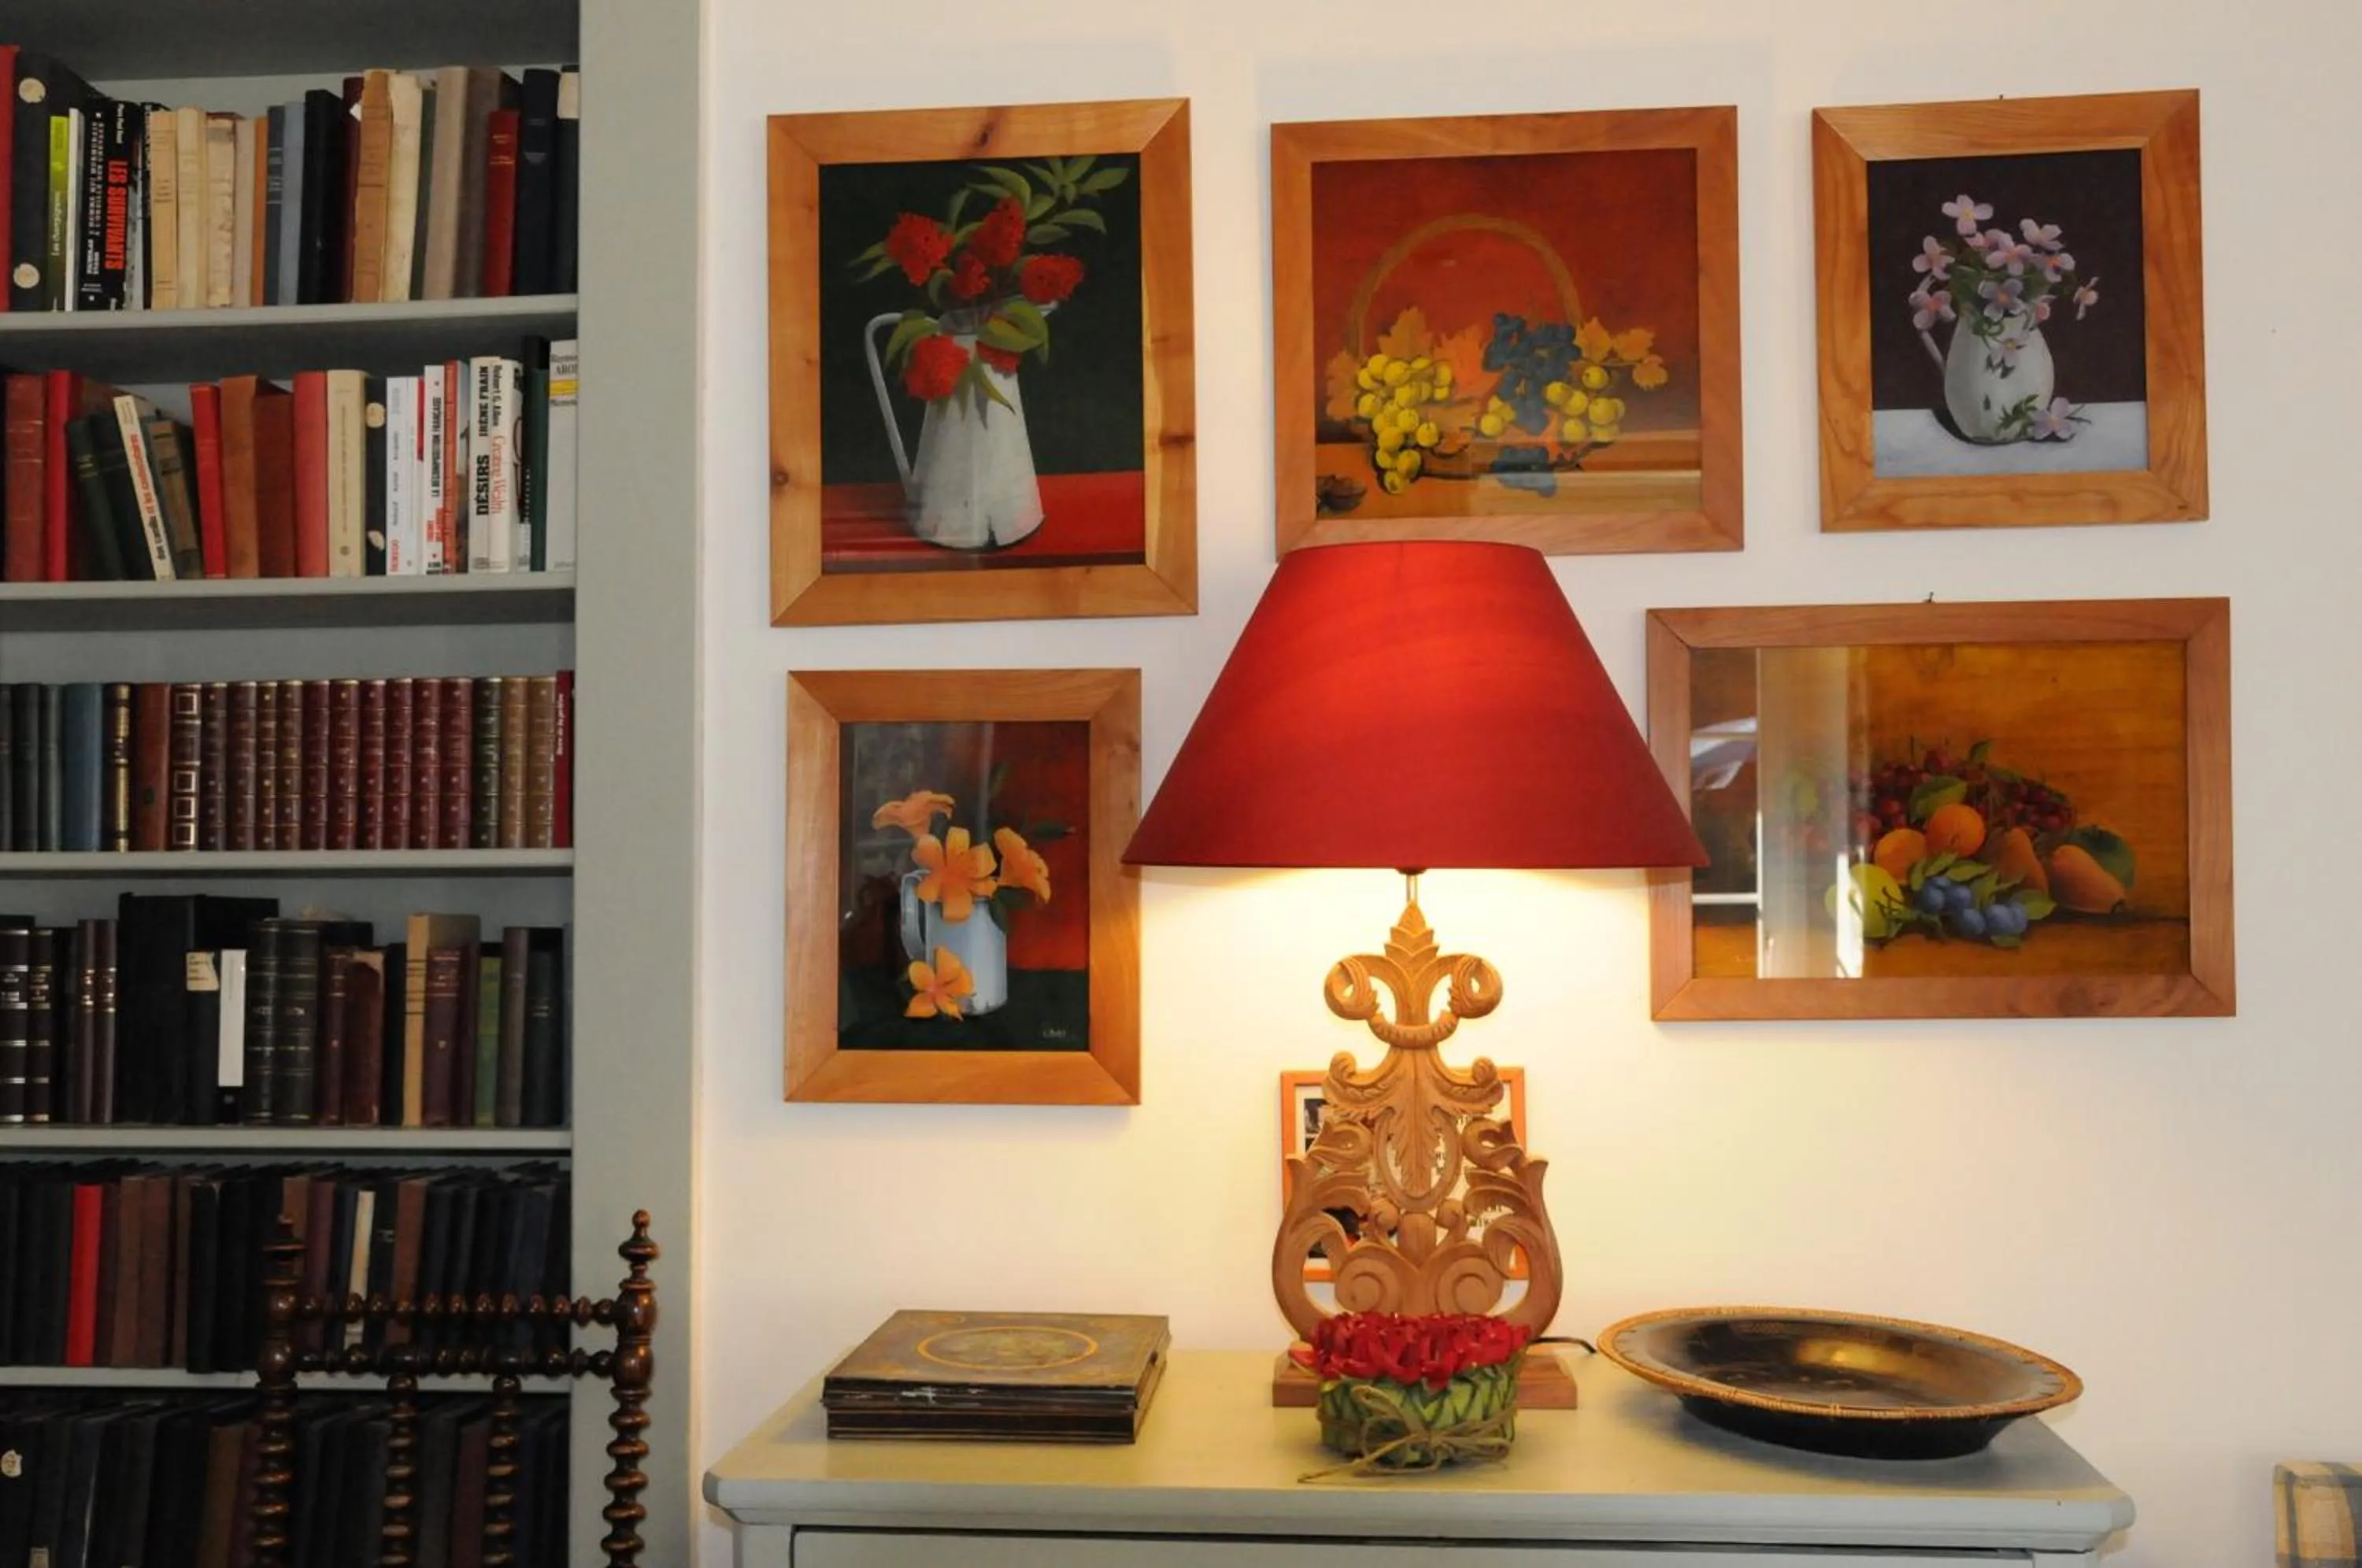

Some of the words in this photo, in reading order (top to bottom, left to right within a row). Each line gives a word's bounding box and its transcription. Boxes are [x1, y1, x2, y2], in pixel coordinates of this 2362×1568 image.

[107, 160, 128, 183] LES
[104, 186, 128, 270] SURVIVANTS
[478, 365, 489, 401] FRAIN
[492, 364, 503, 394] Robert
[431, 489, 441, 497] LA
[476, 454, 490, 516] DÉSIRS
[490, 478, 506, 515] Wealth
